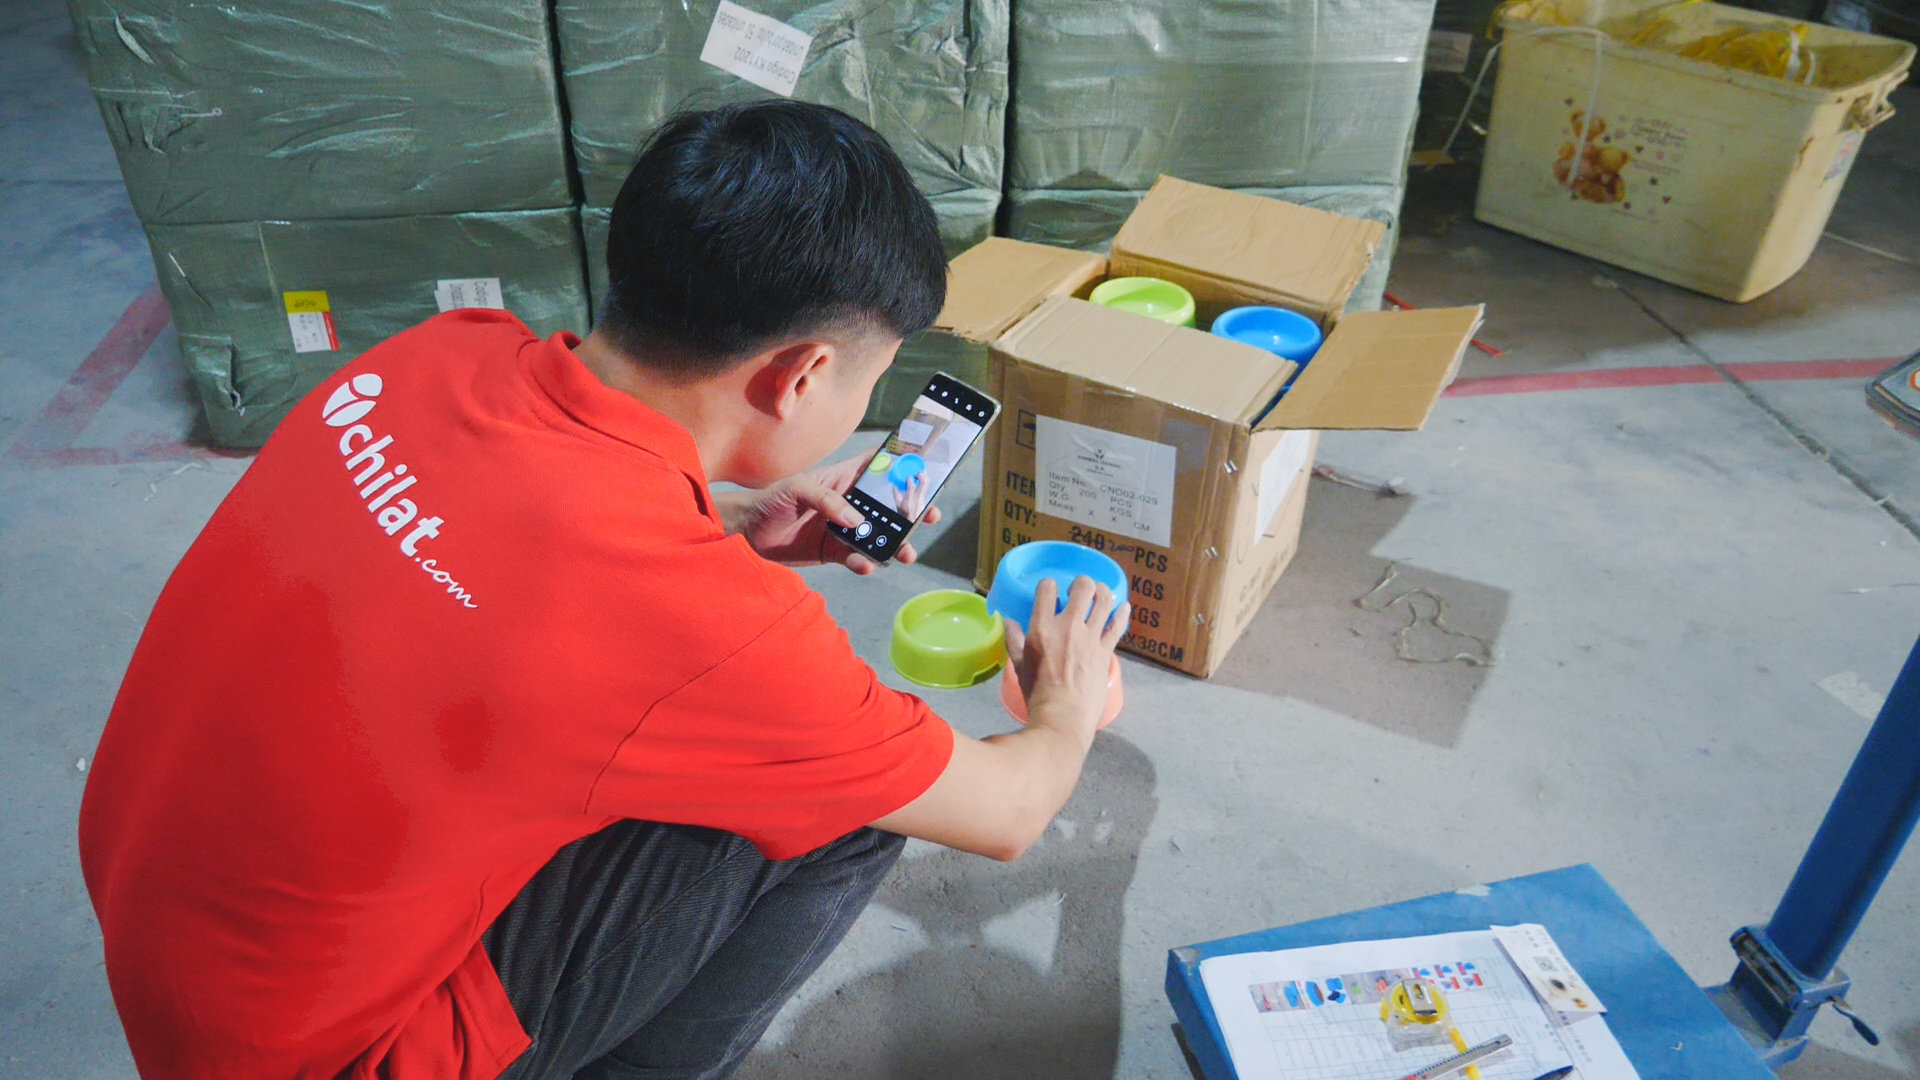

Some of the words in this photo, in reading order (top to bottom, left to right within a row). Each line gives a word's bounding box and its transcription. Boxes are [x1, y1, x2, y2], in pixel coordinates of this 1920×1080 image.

[1079, 488, 1097, 500] 200
[1110, 495, 1132, 508] PCS
[1110, 506, 1132, 518] KGS
[1004, 499, 1037, 528] QTY:
[1134, 546, 1168, 573] PCS
[1133, 521, 1150, 532] CM
[1131, 575, 1164, 601] KGS
